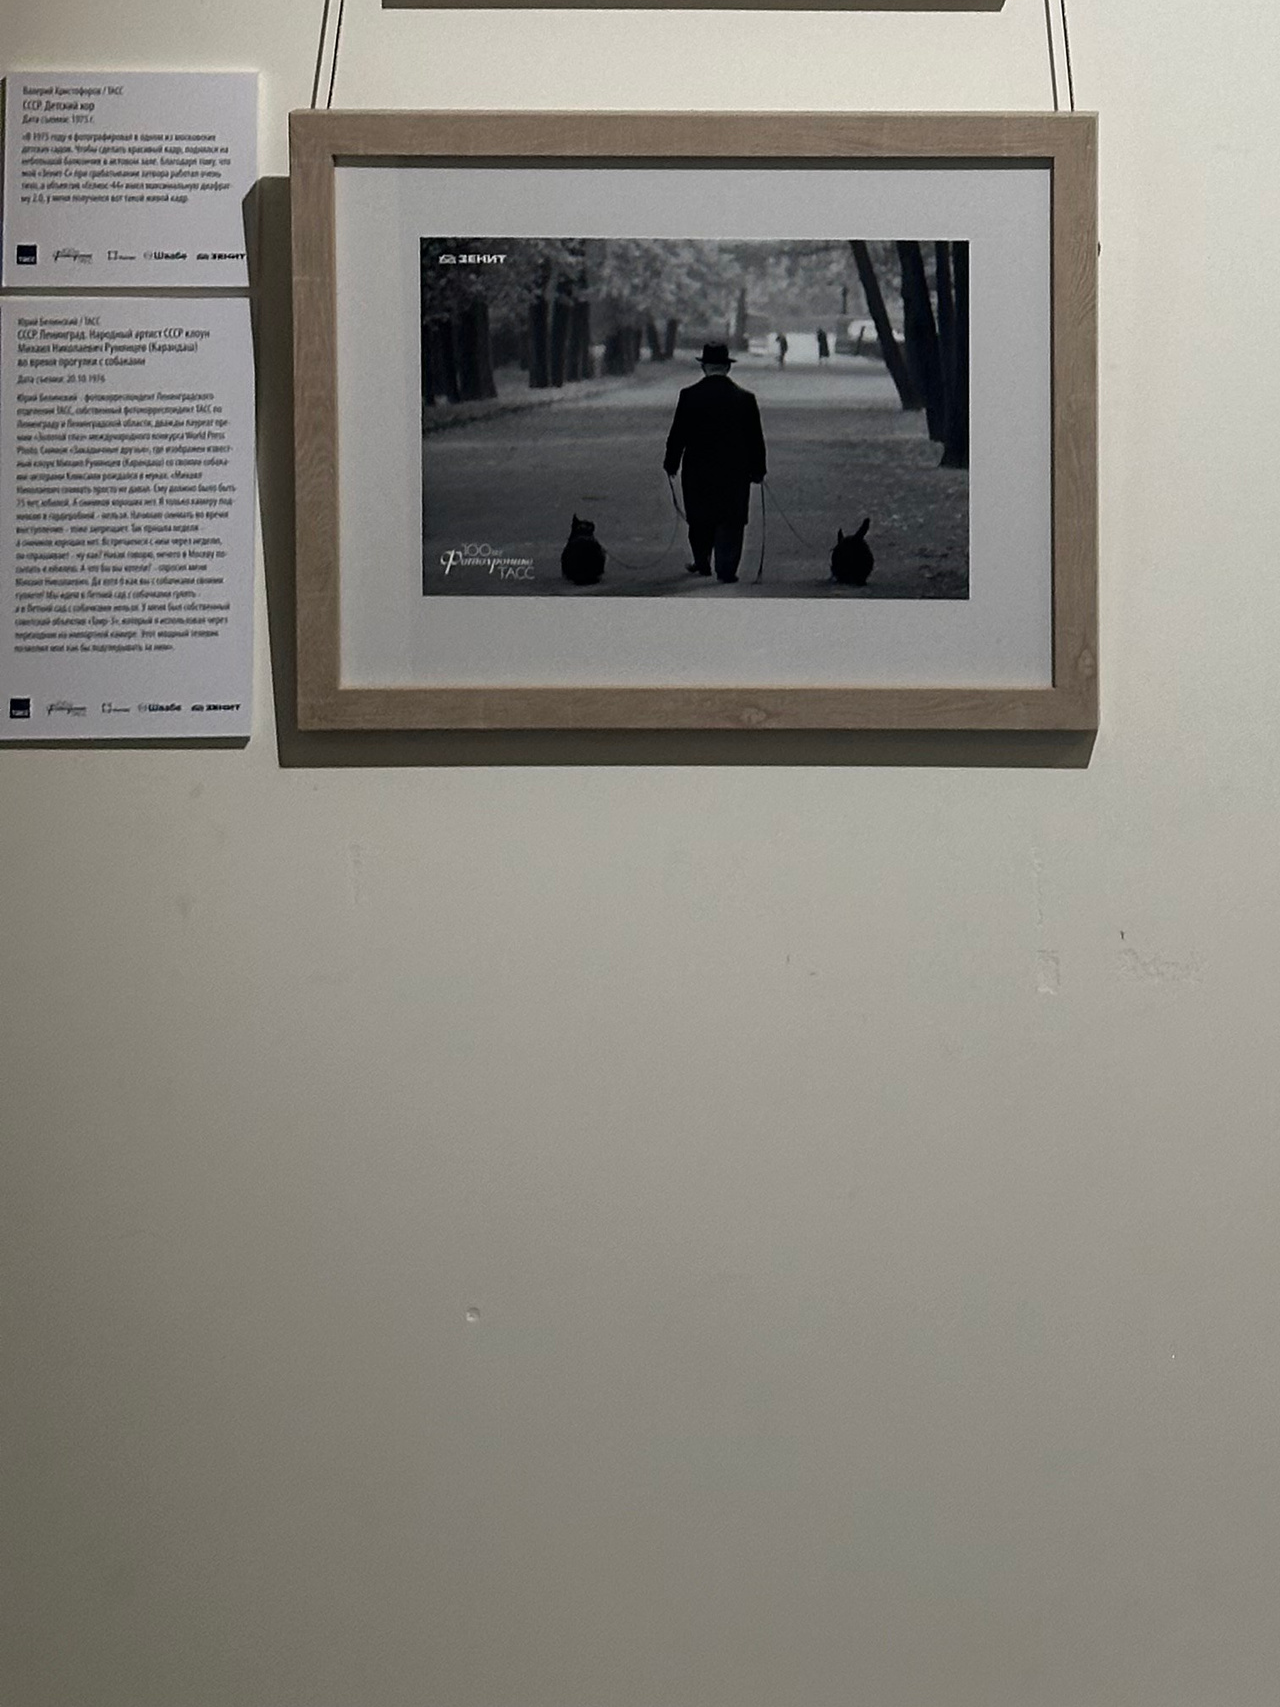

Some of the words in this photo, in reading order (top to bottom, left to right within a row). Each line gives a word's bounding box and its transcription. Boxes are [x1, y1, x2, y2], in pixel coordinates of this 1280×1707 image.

[458, 254, 507, 264] ЗЕНИТ
[461, 543, 491, 557] 100
[497, 566, 535, 580] ТАСС
